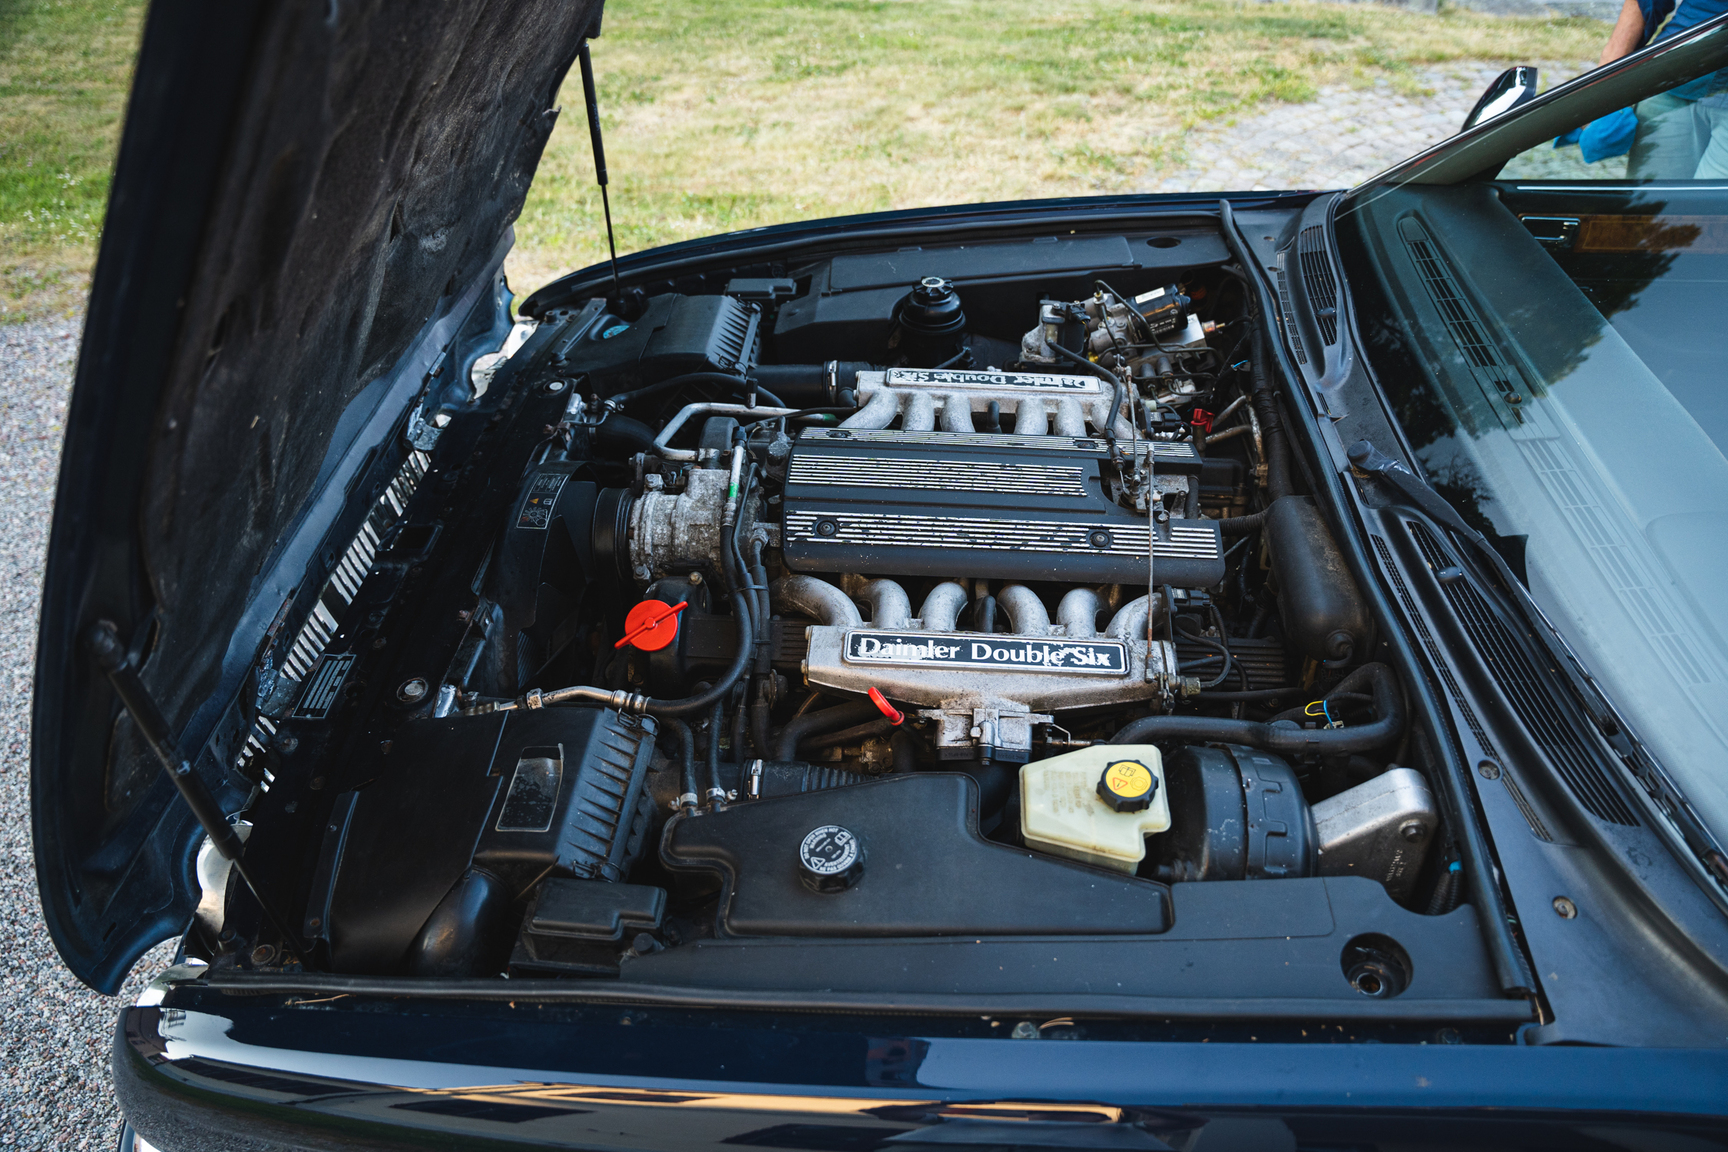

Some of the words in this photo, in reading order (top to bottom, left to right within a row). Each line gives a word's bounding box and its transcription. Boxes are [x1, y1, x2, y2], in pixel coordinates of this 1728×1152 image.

[934, 373, 1007, 384] Double
[861, 637, 960, 659] Daimler
[971, 642, 1064, 665] Double
[1071, 647, 1111, 667] Six
